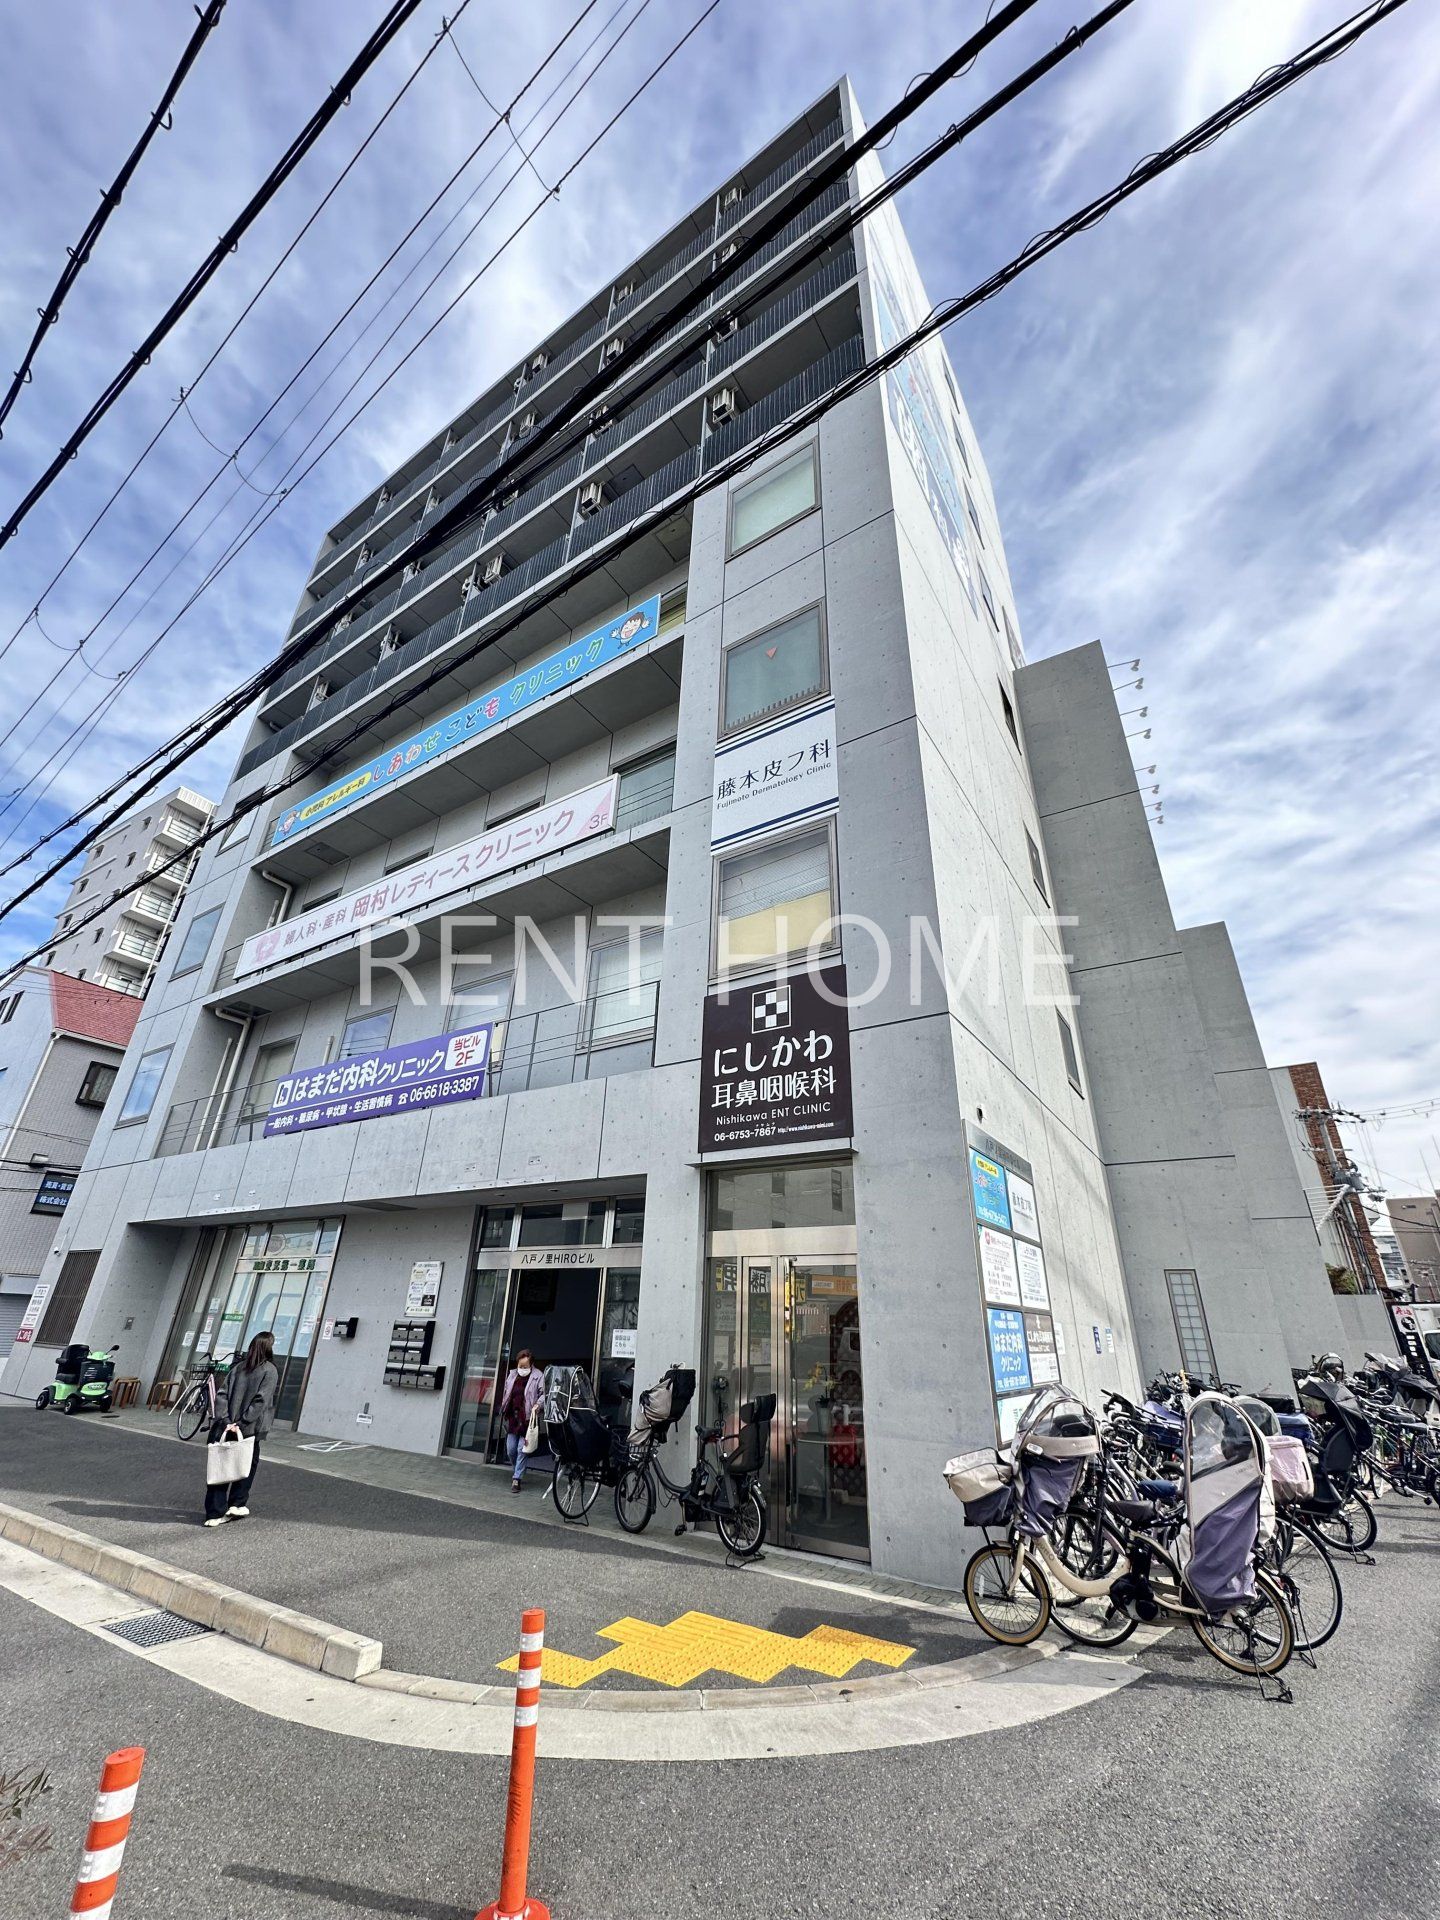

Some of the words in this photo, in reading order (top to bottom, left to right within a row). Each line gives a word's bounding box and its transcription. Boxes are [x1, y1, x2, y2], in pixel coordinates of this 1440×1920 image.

[716, 738, 832, 801] 藤本皮フ科
[716, 794, 750, 810] Fujimoto
[752, 773, 804, 797] Dermatology
[806, 762, 832, 777] Clinic
[589, 813, 608, 830] 3F
[453, 1034, 481, 1052] 当ビル
[714, 1029, 833, 1077] にしかわ
[454, 1051, 475, 1067] 2F
[290, 1048, 445, 1103] はまだ内科クリニック
[711, 1065, 837, 1109] 耳鼻咽喉科
[716, 1111, 768, 1126] Nishikawa
[771, 1107, 790, 1119] ENT
[793, 1101, 831, 1116] CLINIC
[714, 1125, 776, 1142] 06-6753-7867
[520, 1253, 595, 1265] 八戸ノ里HIROビル
